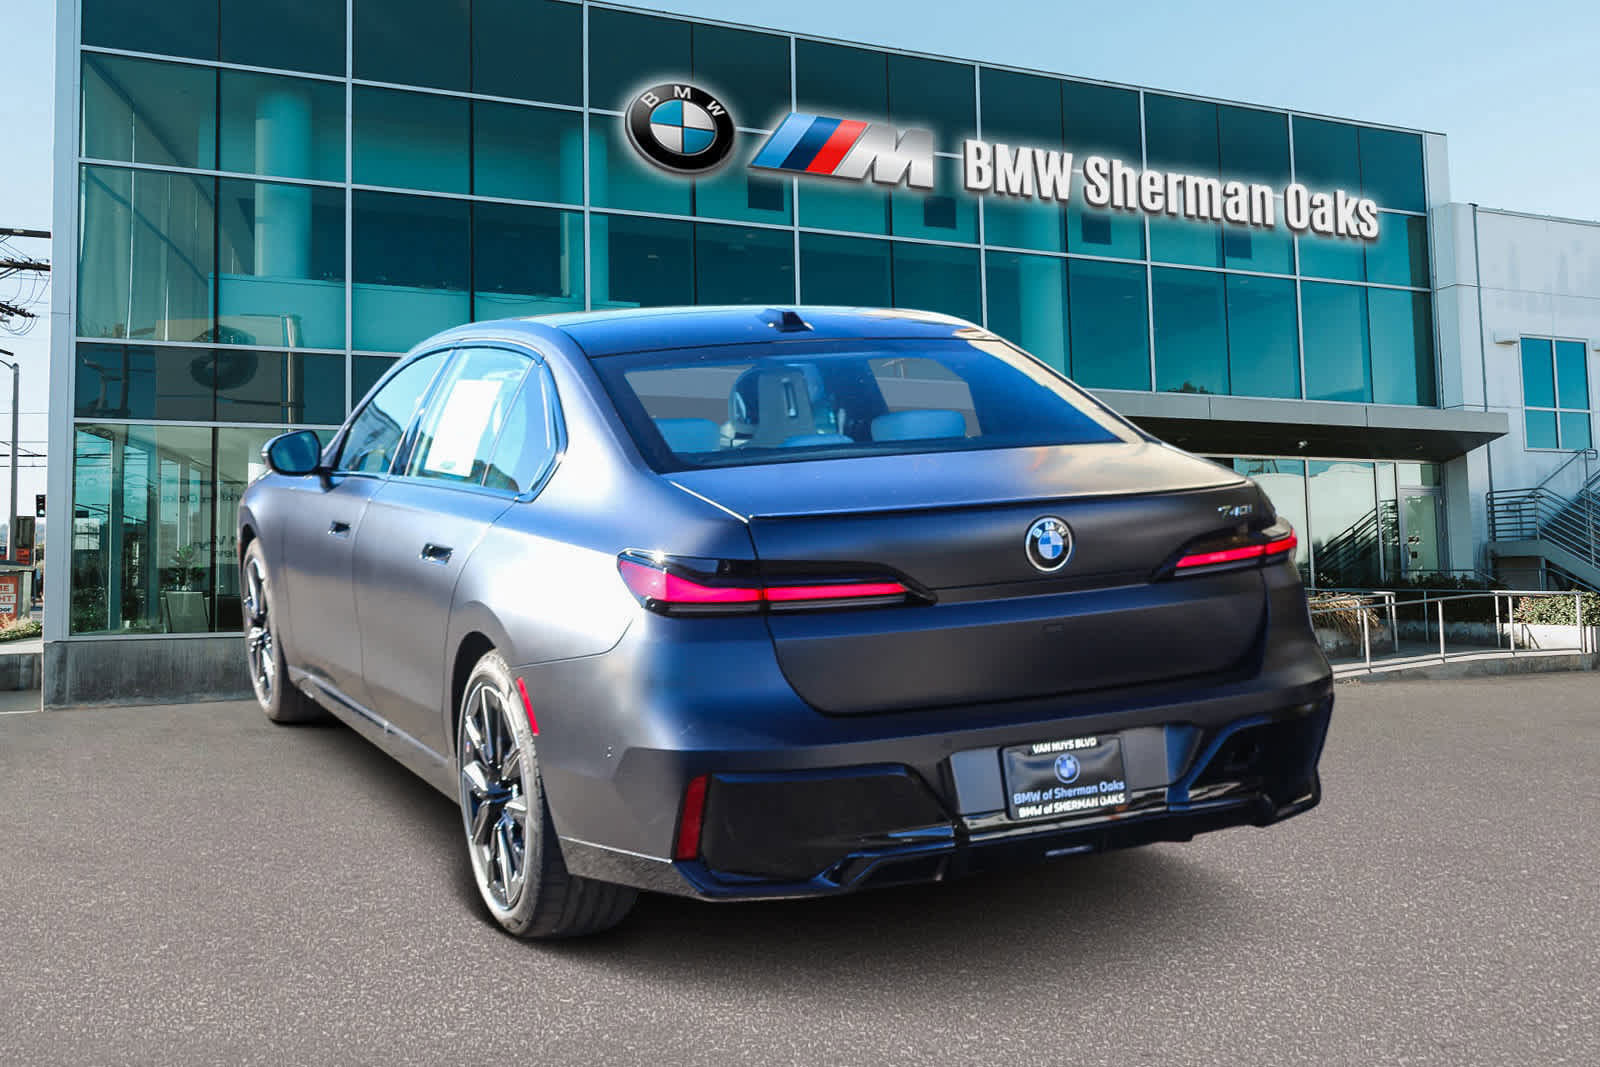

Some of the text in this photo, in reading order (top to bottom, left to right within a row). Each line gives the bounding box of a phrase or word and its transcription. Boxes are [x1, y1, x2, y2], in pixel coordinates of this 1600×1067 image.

[641, 84, 726, 117] BMW
[963, 138, 1380, 241] BMW Sherman Oaks
[1032, 521, 1068, 538] BMW
[1032, 742, 1051, 754] VAN
[1075, 736, 1097, 749] BLVD
[1013, 780, 1125, 804] BMW of Sherman Oaks
[1019, 793, 1126, 818] BMW of SHERMAN OAKS
